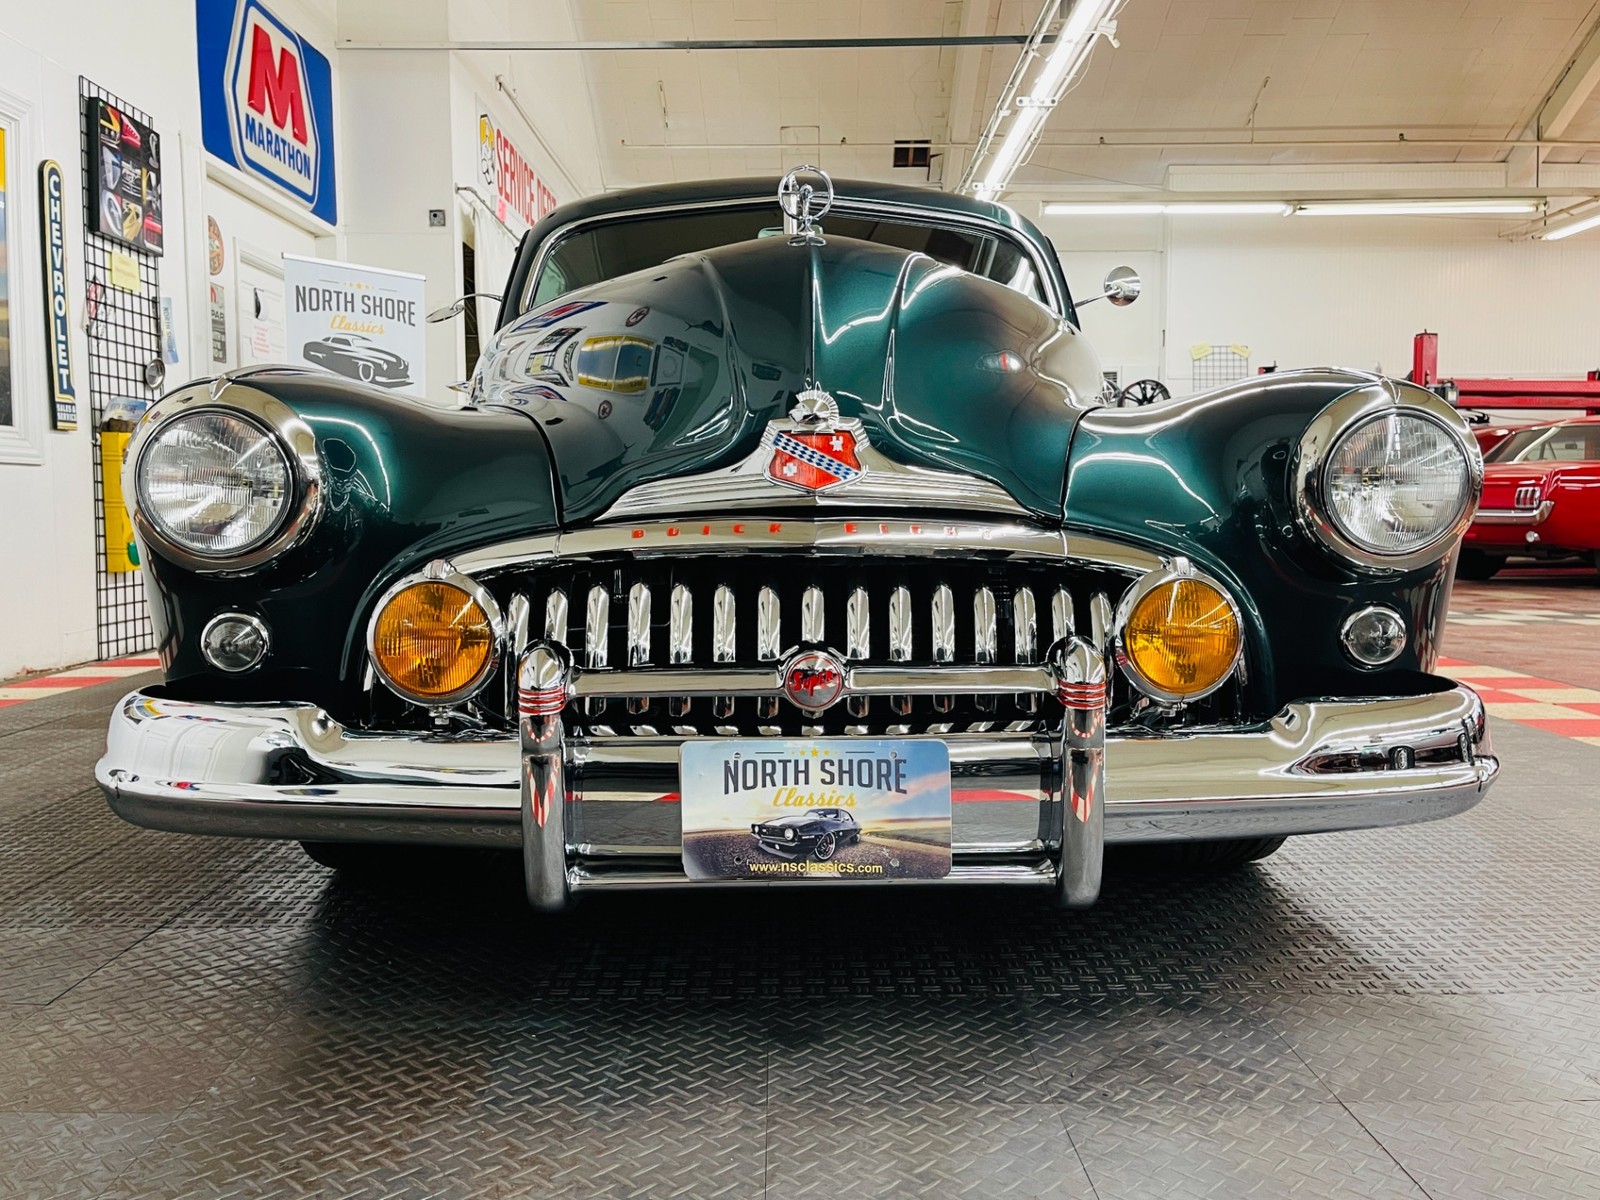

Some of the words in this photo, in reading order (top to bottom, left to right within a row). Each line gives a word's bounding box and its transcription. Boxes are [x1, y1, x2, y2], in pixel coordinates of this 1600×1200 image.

[245, 116, 311, 180] MARATHON
[497, 128, 535, 227] SERVICE
[49, 175, 70, 391] CHEVROLET
[295, 285, 355, 313] NORTH
[361, 295, 416, 326] SHORE
[330, 314, 385, 335] Classics
[632, 523, 782, 539] BUICK
[723, 759, 810, 795] NORTH
[820, 759, 908, 794] SHORE
[772, 787, 857, 807] Classics
[750, 861, 883, 873] www.nsclassics.com
